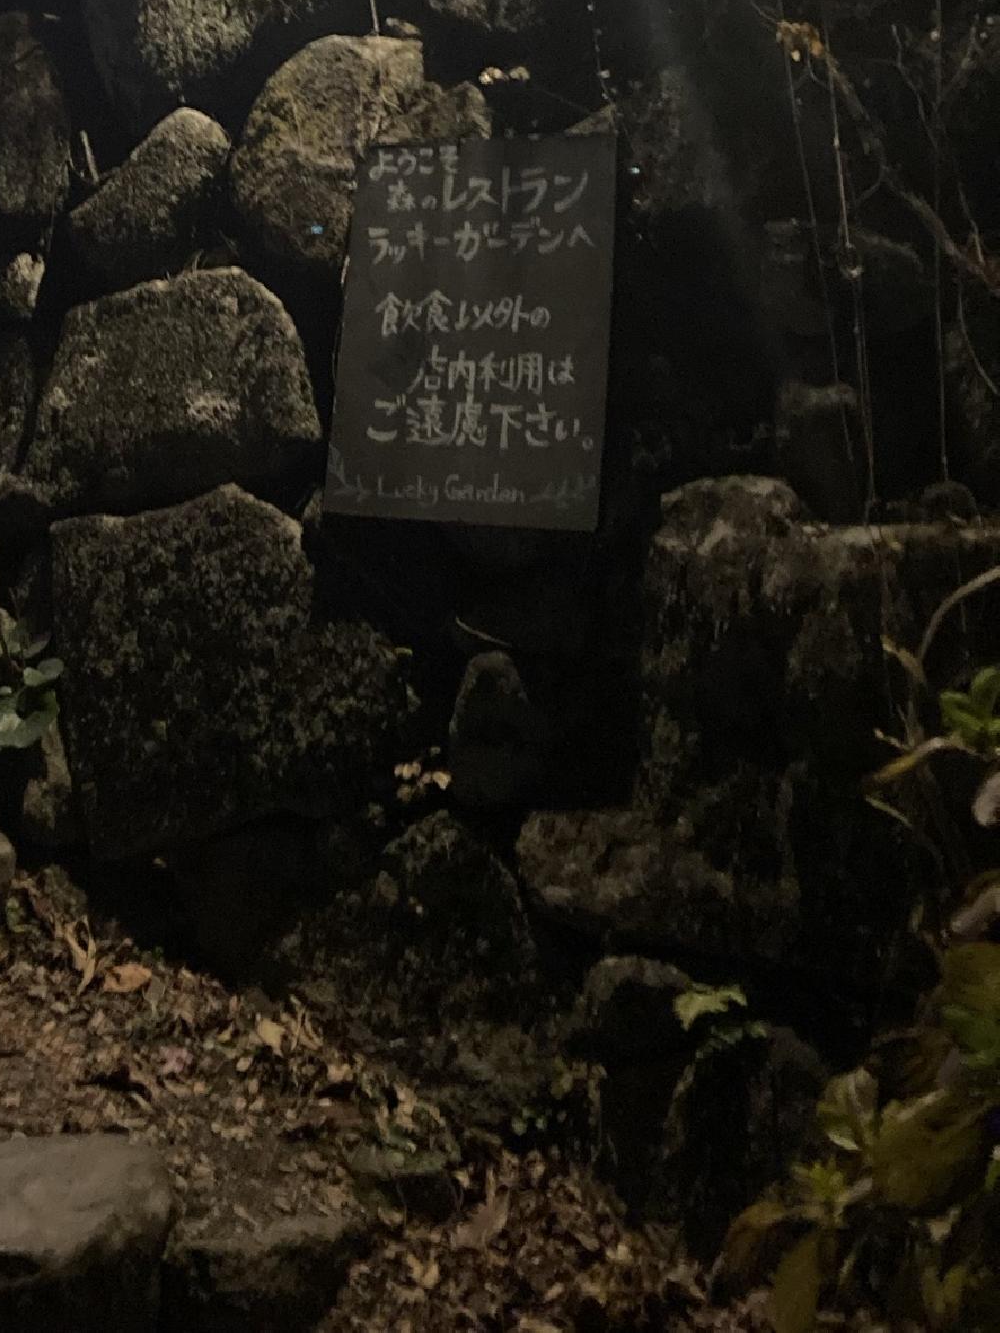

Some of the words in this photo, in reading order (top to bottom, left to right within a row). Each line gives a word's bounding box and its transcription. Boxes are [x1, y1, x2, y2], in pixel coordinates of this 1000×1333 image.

[368, 145, 458, 180] ようこそ
[387, 166, 587, 213] 森のレストラン
[367, 220, 596, 265] ラッキーガーデンへ
[375, 289, 551, 337] 飲食以外の
[407, 344, 575, 394] 店内利用は
[366, 393, 594, 451] ご遠慮下さい。
[443, 474, 525, 505] Garden
